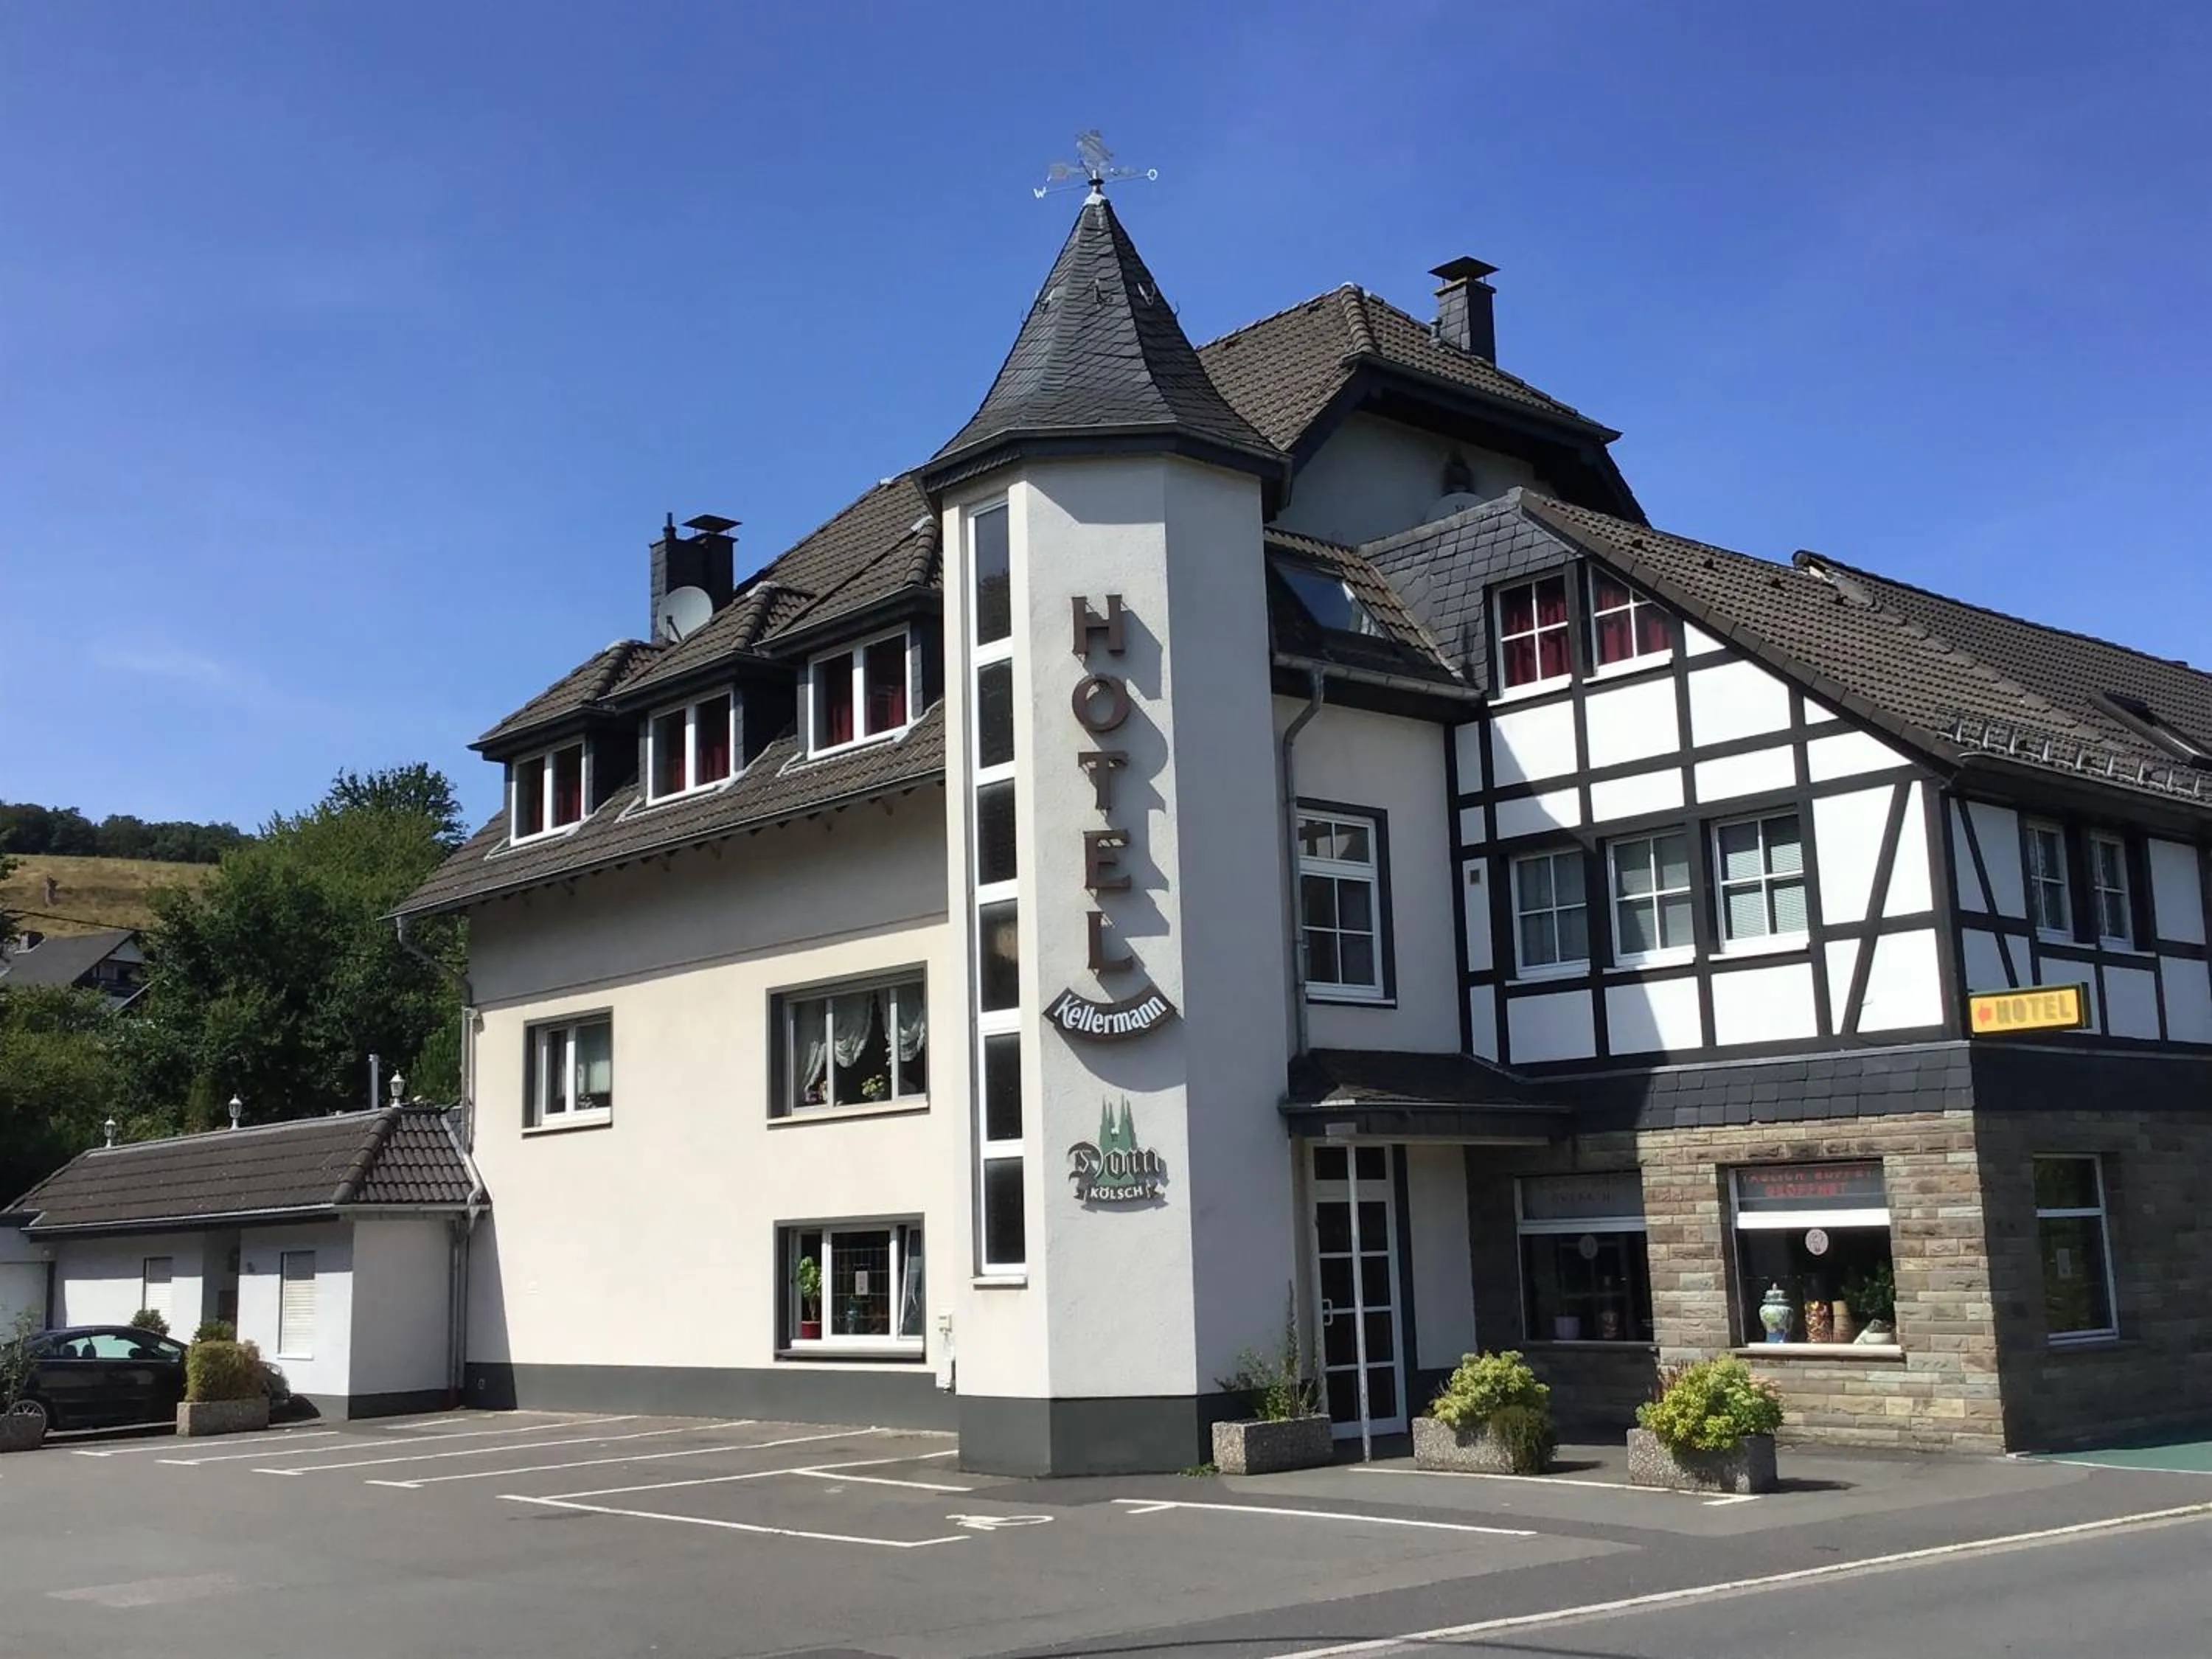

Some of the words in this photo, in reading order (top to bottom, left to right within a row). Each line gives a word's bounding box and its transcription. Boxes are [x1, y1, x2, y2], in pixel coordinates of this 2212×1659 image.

[1033, 187, 1046, 199] W
[1072, 594, 1133, 970] HOTEL
[1052, 993, 1168, 1034] Kellermann
[1995, 992, 2073, 1024] HOTEL
[1068, 1141, 1160, 1181] Dom
[1091, 1185, 1144, 1200] KÖLSCH
